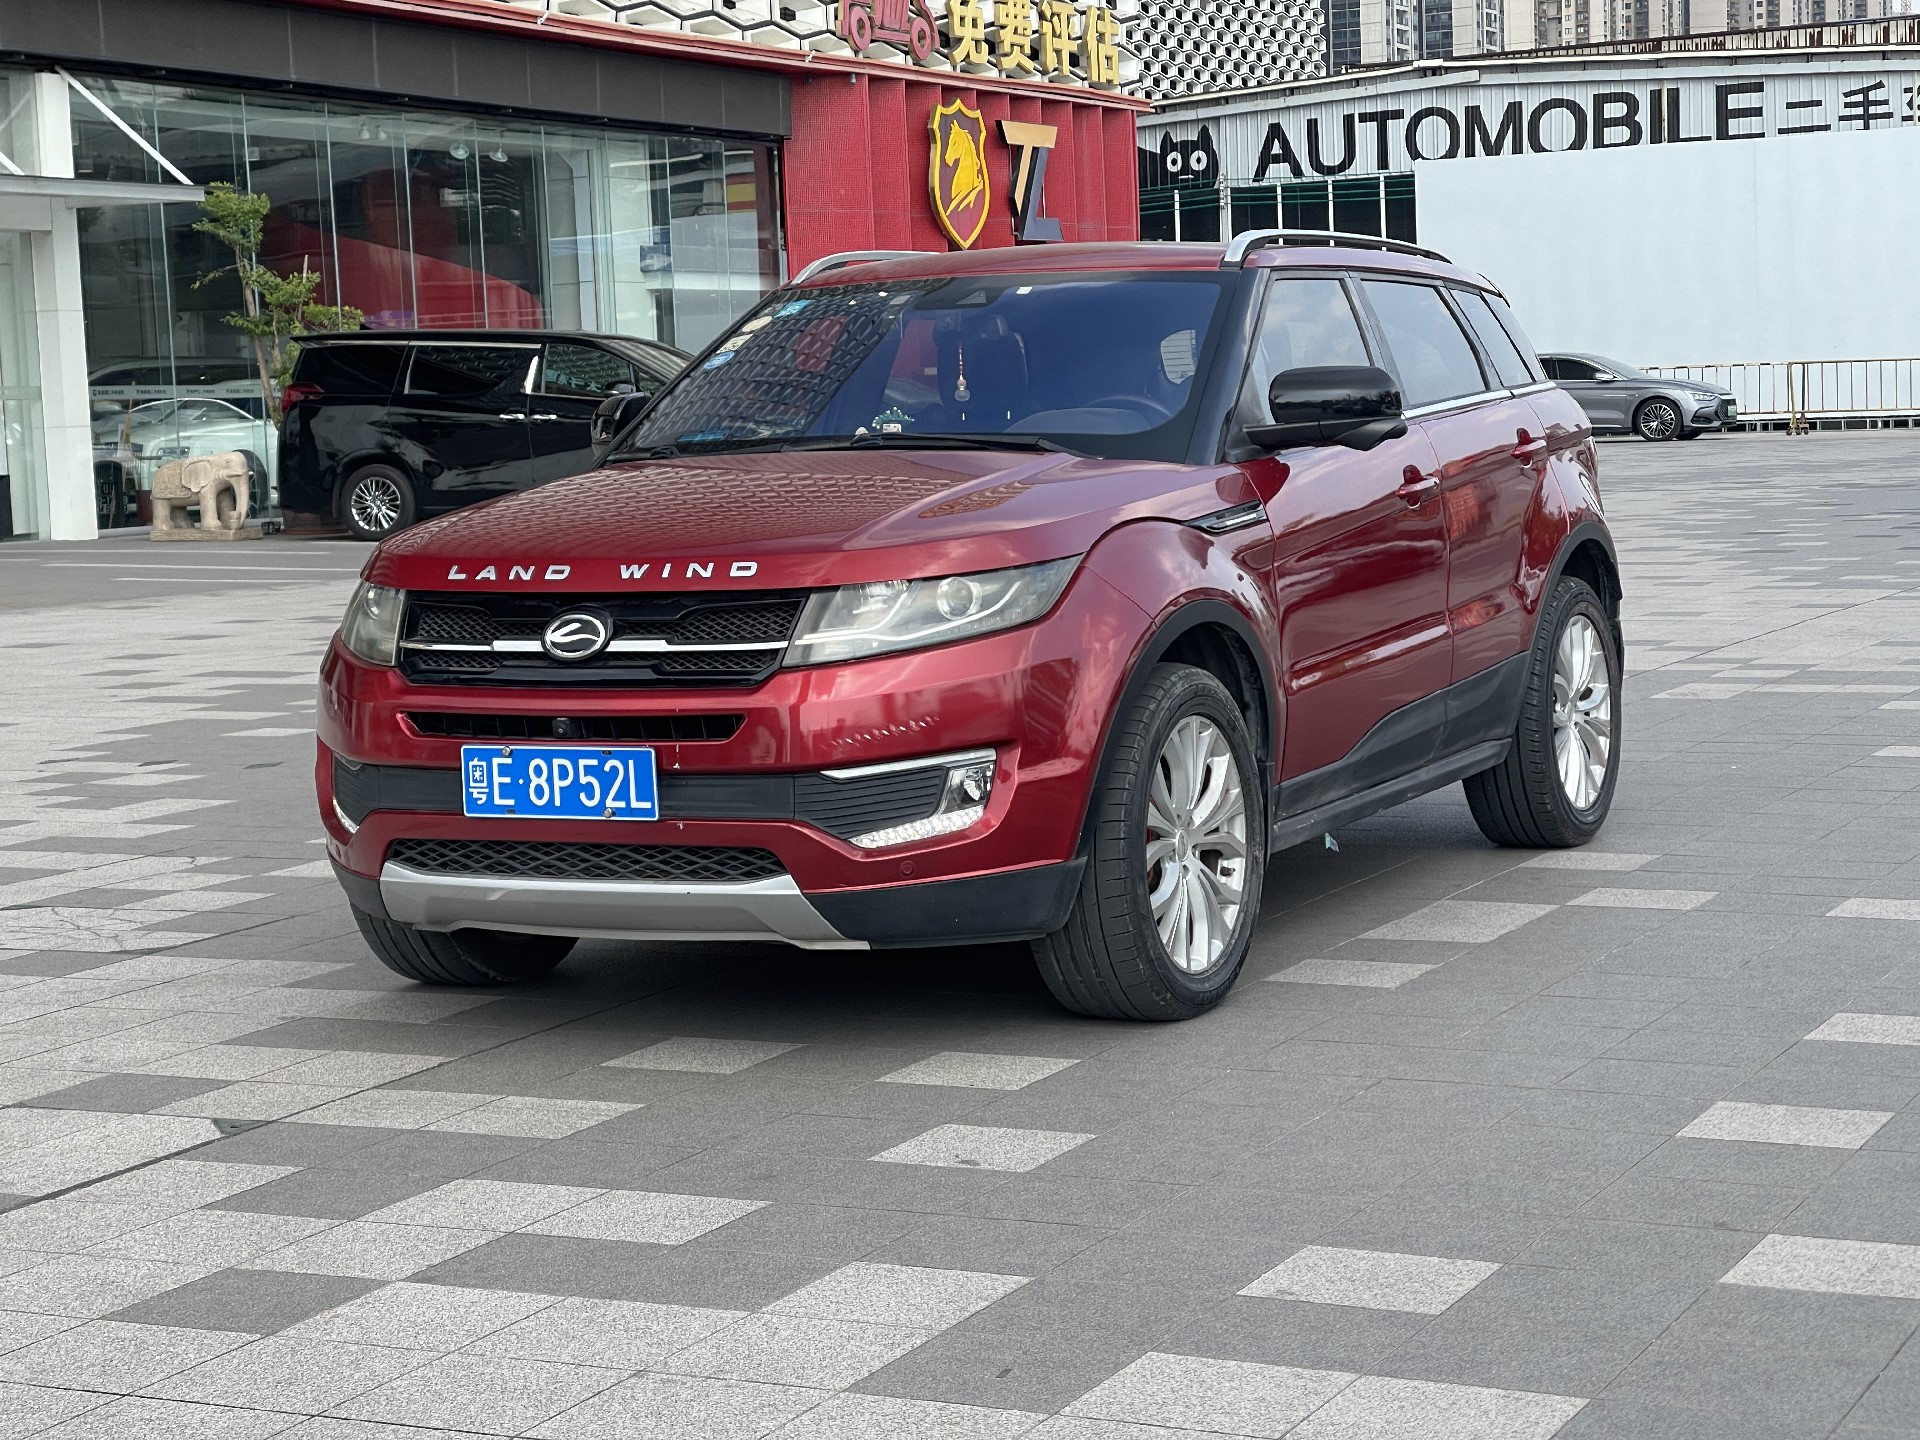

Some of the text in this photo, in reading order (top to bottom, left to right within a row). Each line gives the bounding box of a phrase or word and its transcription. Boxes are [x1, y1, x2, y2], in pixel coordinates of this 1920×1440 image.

[946, 0, 1120, 85] 免费评估
[1252, 81, 1766, 182] AUTOMOBILE
[447, 561, 758, 580] LAND WIND
